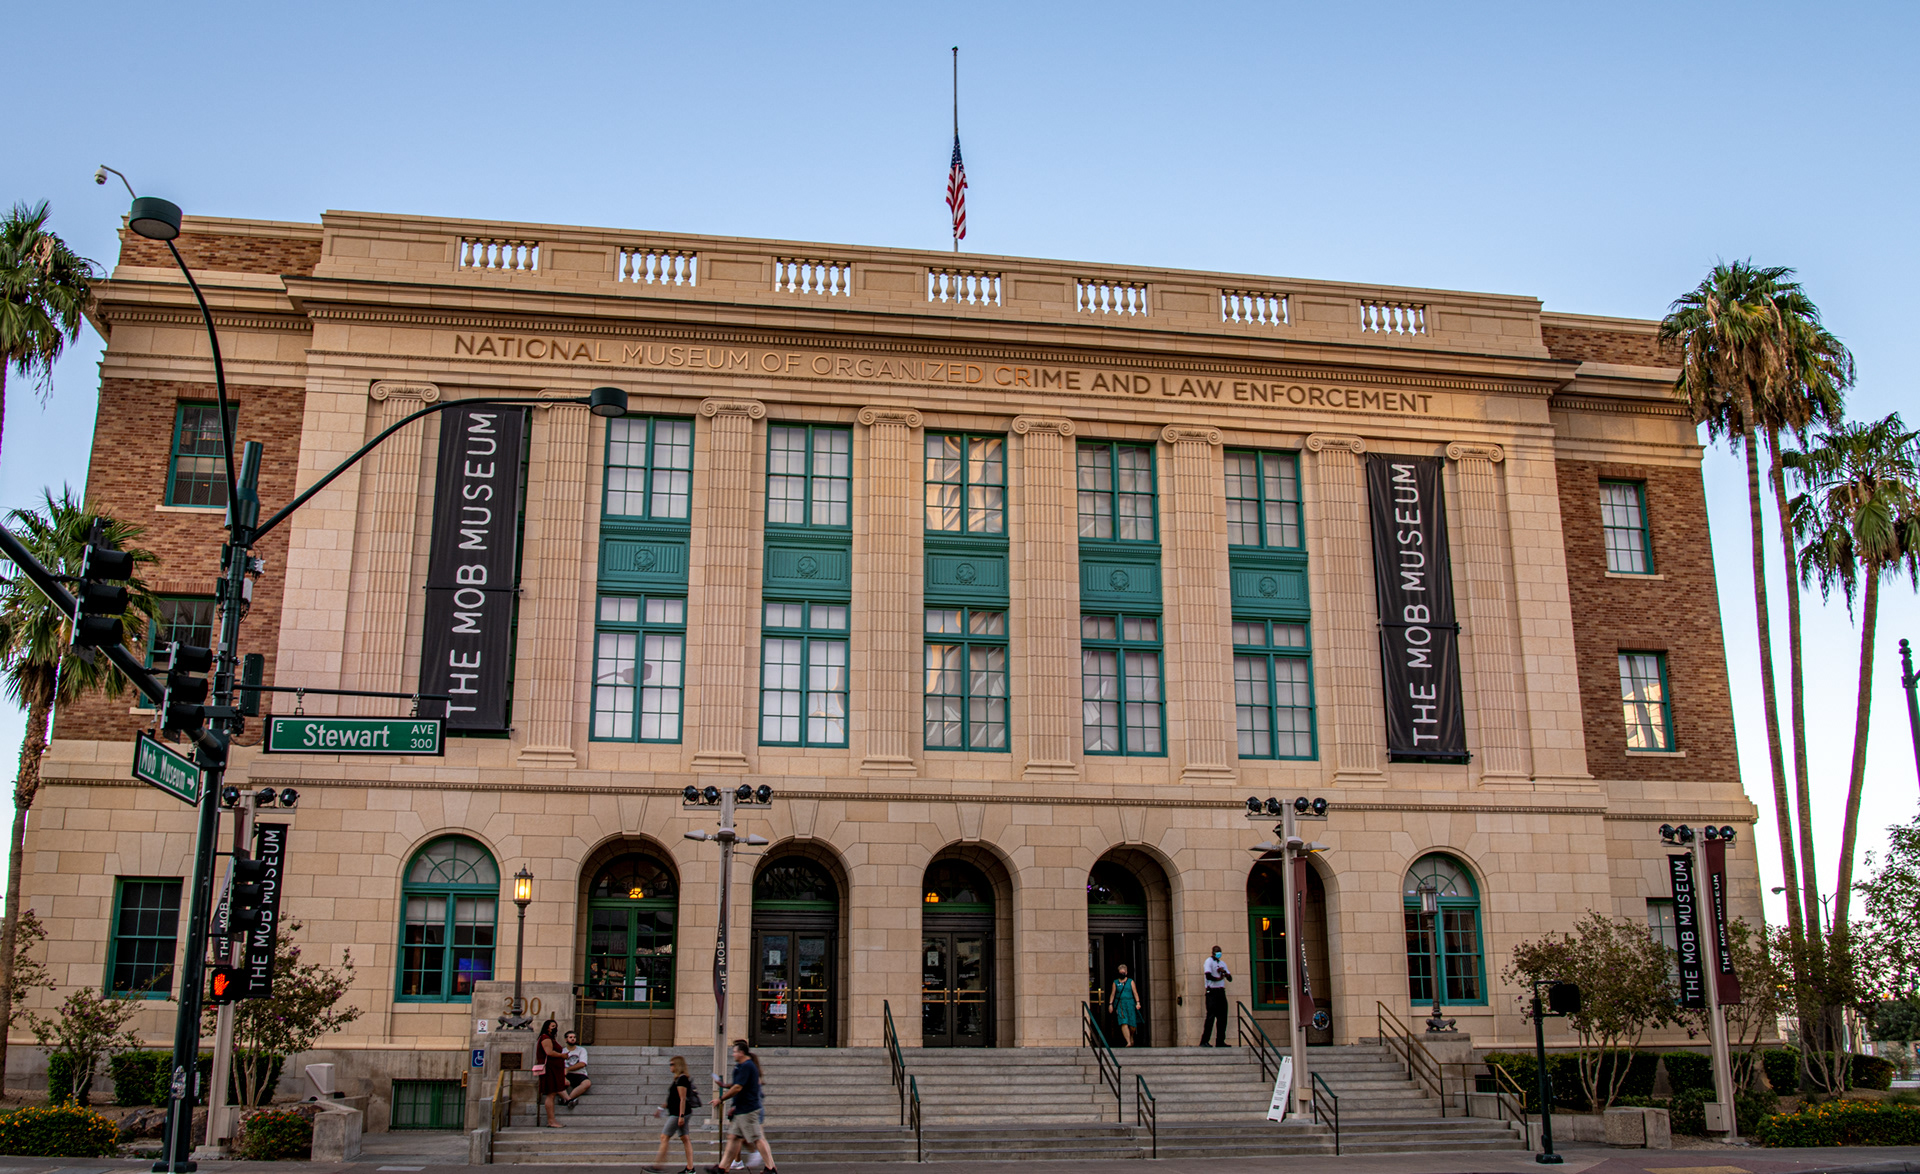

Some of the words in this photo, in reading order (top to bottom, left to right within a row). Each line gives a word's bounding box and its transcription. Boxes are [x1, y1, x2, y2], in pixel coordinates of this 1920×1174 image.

[455, 334, 611, 363] NATIONAL
[622, 343, 750, 371] MUSEUM
[760, 352, 801, 374] OF
[811, 355, 984, 384] ORGANIZED
[993, 366, 1082, 391] CRIME
[1090, 372, 1151, 395] AND
[1161, 376, 1223, 400] LAW
[1233, 381, 1433, 414] ENFORCEMENT
[458, 412, 498, 551] MUSEUM
[1391, 463, 1426, 592] MUSEUM
[452, 563, 489, 634] MOB
[1404, 603, 1433, 669] MOB
[445, 649, 481, 719] THE
[276, 722, 284, 733] E
[303, 723, 391, 748] Stewart
[411, 724, 434, 735] AVE
[1409, 682, 1439, 747] THE
[141, 743, 157, 775] Mob
[160, 754, 186, 791] Museum
[410, 738, 433, 749] 300
[1674, 860, 1693, 926] MUSEUM
[1712, 874, 1724, 920] MUSEUM
[717, 940, 726, 966] MOB
[1681, 931, 1697, 964] MOB
[1719, 924, 1728, 947] MOB
[249, 954, 269, 991] THE
[1684, 969, 1700, 1001] THE
